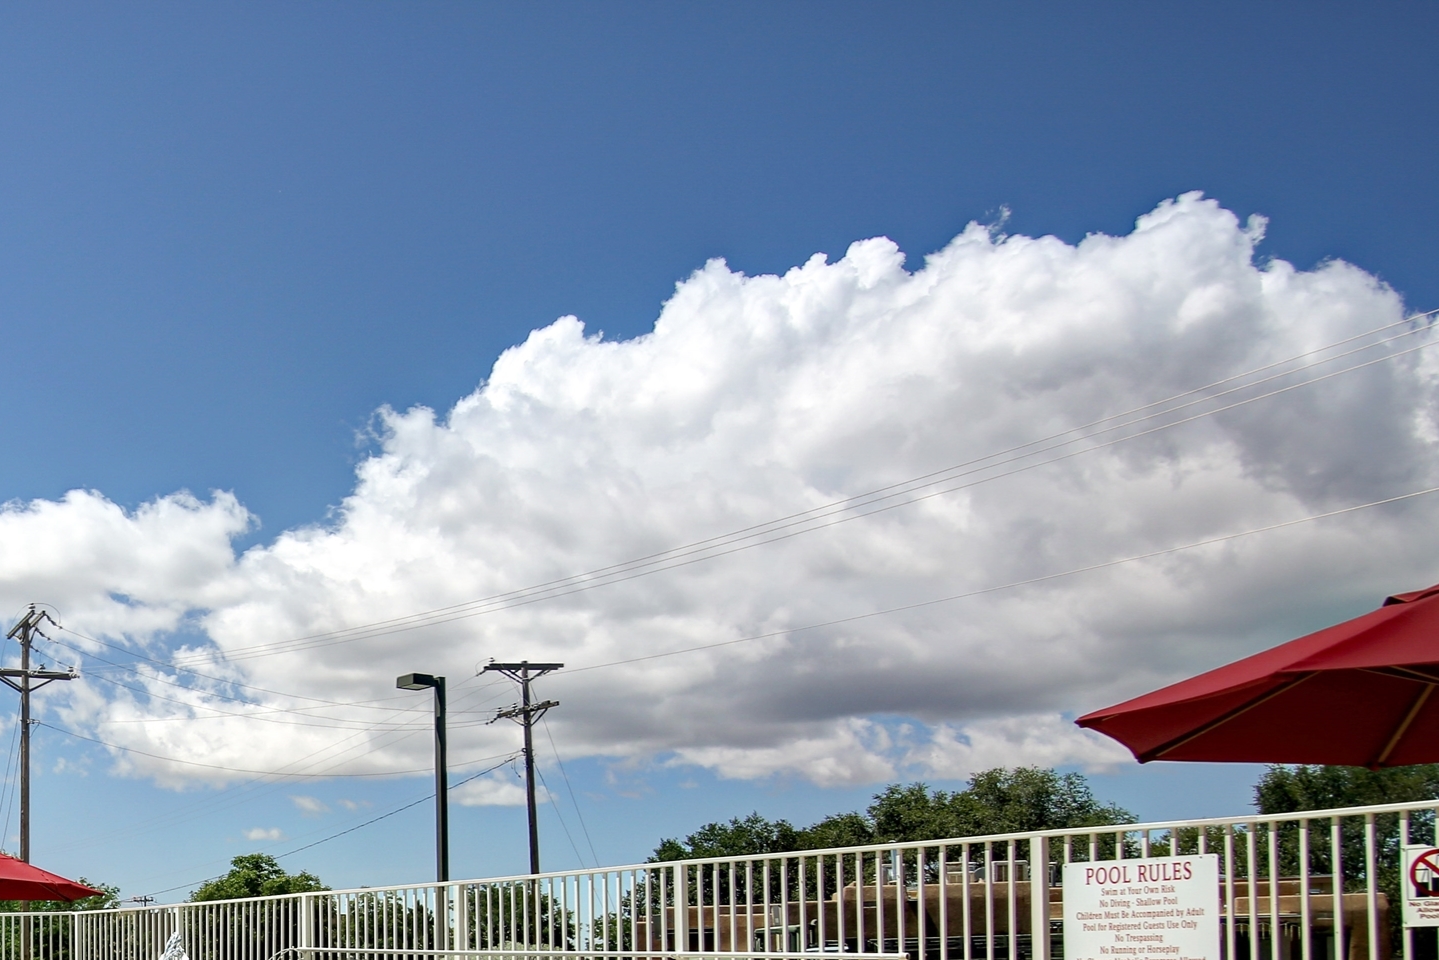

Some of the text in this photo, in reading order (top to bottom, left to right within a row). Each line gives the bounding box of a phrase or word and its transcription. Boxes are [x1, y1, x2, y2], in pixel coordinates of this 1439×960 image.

[1085, 861, 1192, 885] POOL RULES
[1101, 884, 1176, 896] Swim at Your Own Risk
[1099, 900, 1108, 908] No
[1110, 899, 1131, 909] Diving
[1136, 898, 1161, 906] Shallow
[1163, 896, 1178, 905] Pool
[1076, 907, 1205, 920] Children Must Be Accompanied by Adult
[1083, 919, 1198, 933] Pool for Registered Guests Use Only
[1115, 933, 1163, 943] No Trespassing
[1100, 946, 1109, 954] No
[1111, 945, 1137, 956] Running
[1147, 945, 1180, 955] Horseplay
